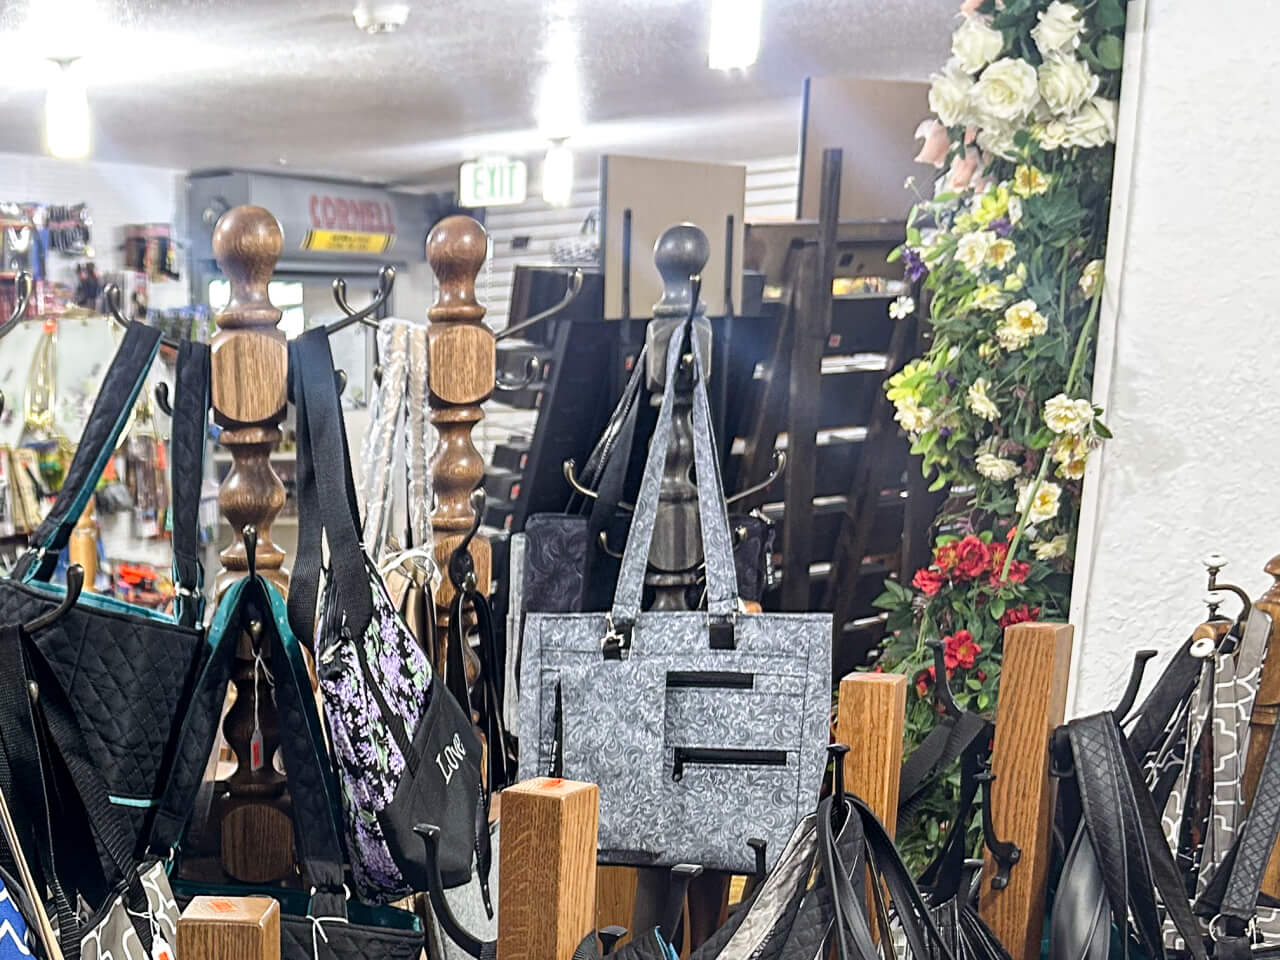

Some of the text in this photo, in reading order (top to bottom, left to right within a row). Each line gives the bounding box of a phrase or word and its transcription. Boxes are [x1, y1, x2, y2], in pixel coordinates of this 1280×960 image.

[474, 166, 516, 200] EXIT
[310, 194, 395, 233] CORNELL
[435, 732, 466, 785] Love
